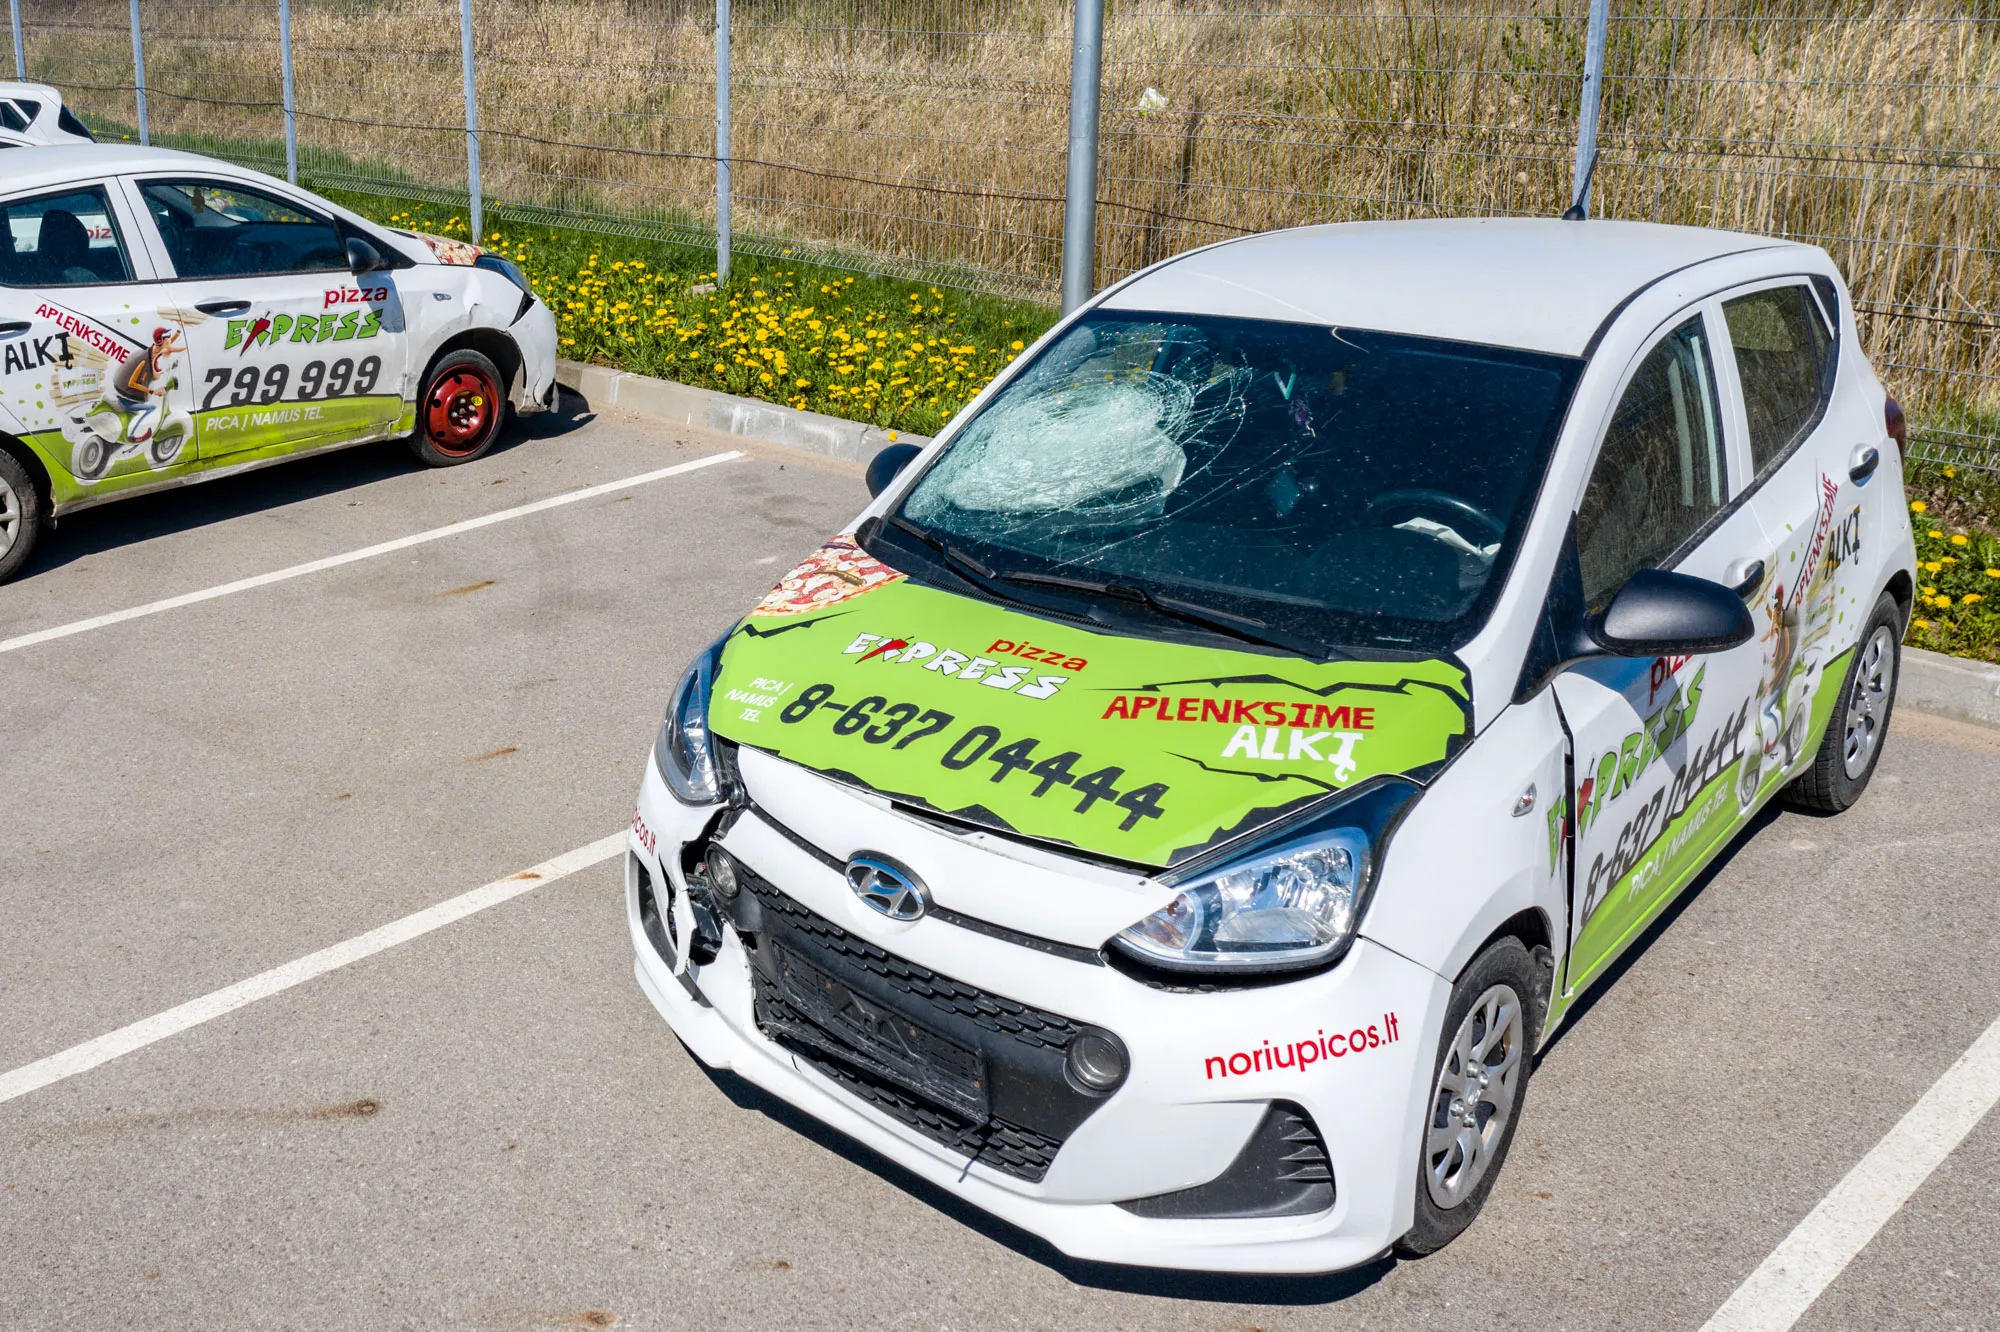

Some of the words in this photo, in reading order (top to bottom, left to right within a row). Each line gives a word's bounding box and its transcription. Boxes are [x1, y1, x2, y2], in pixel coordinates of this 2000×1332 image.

[323, 286, 388, 308] pizza
[35, 303, 130, 364] APLENKSIME
[224, 309, 383, 357] EXPRESS
[202, 363, 290, 410] 799
[298, 355, 382, 400] 999
[205, 415, 239, 431] PICA
[251, 408, 300, 427] NAMUS
[1794, 472, 1838, 615] APLENKSIME
[841, 632, 1069, 700] EXPRESS
[985, 639, 1088, 672] pizza
[724, 688, 778, 708] NAMUS
[748, 677, 784, 692] PICA
[1101, 696, 1375, 730] APLENKSIME
[780, 683, 955, 750] 8-637
[940, 725, 1170, 832] 04444
[1548, 661, 1706, 879] EXPRESS
[1661, 695, 1749, 830] 04444
[1205, 1012, 1399, 1079] noriupicos.lt
